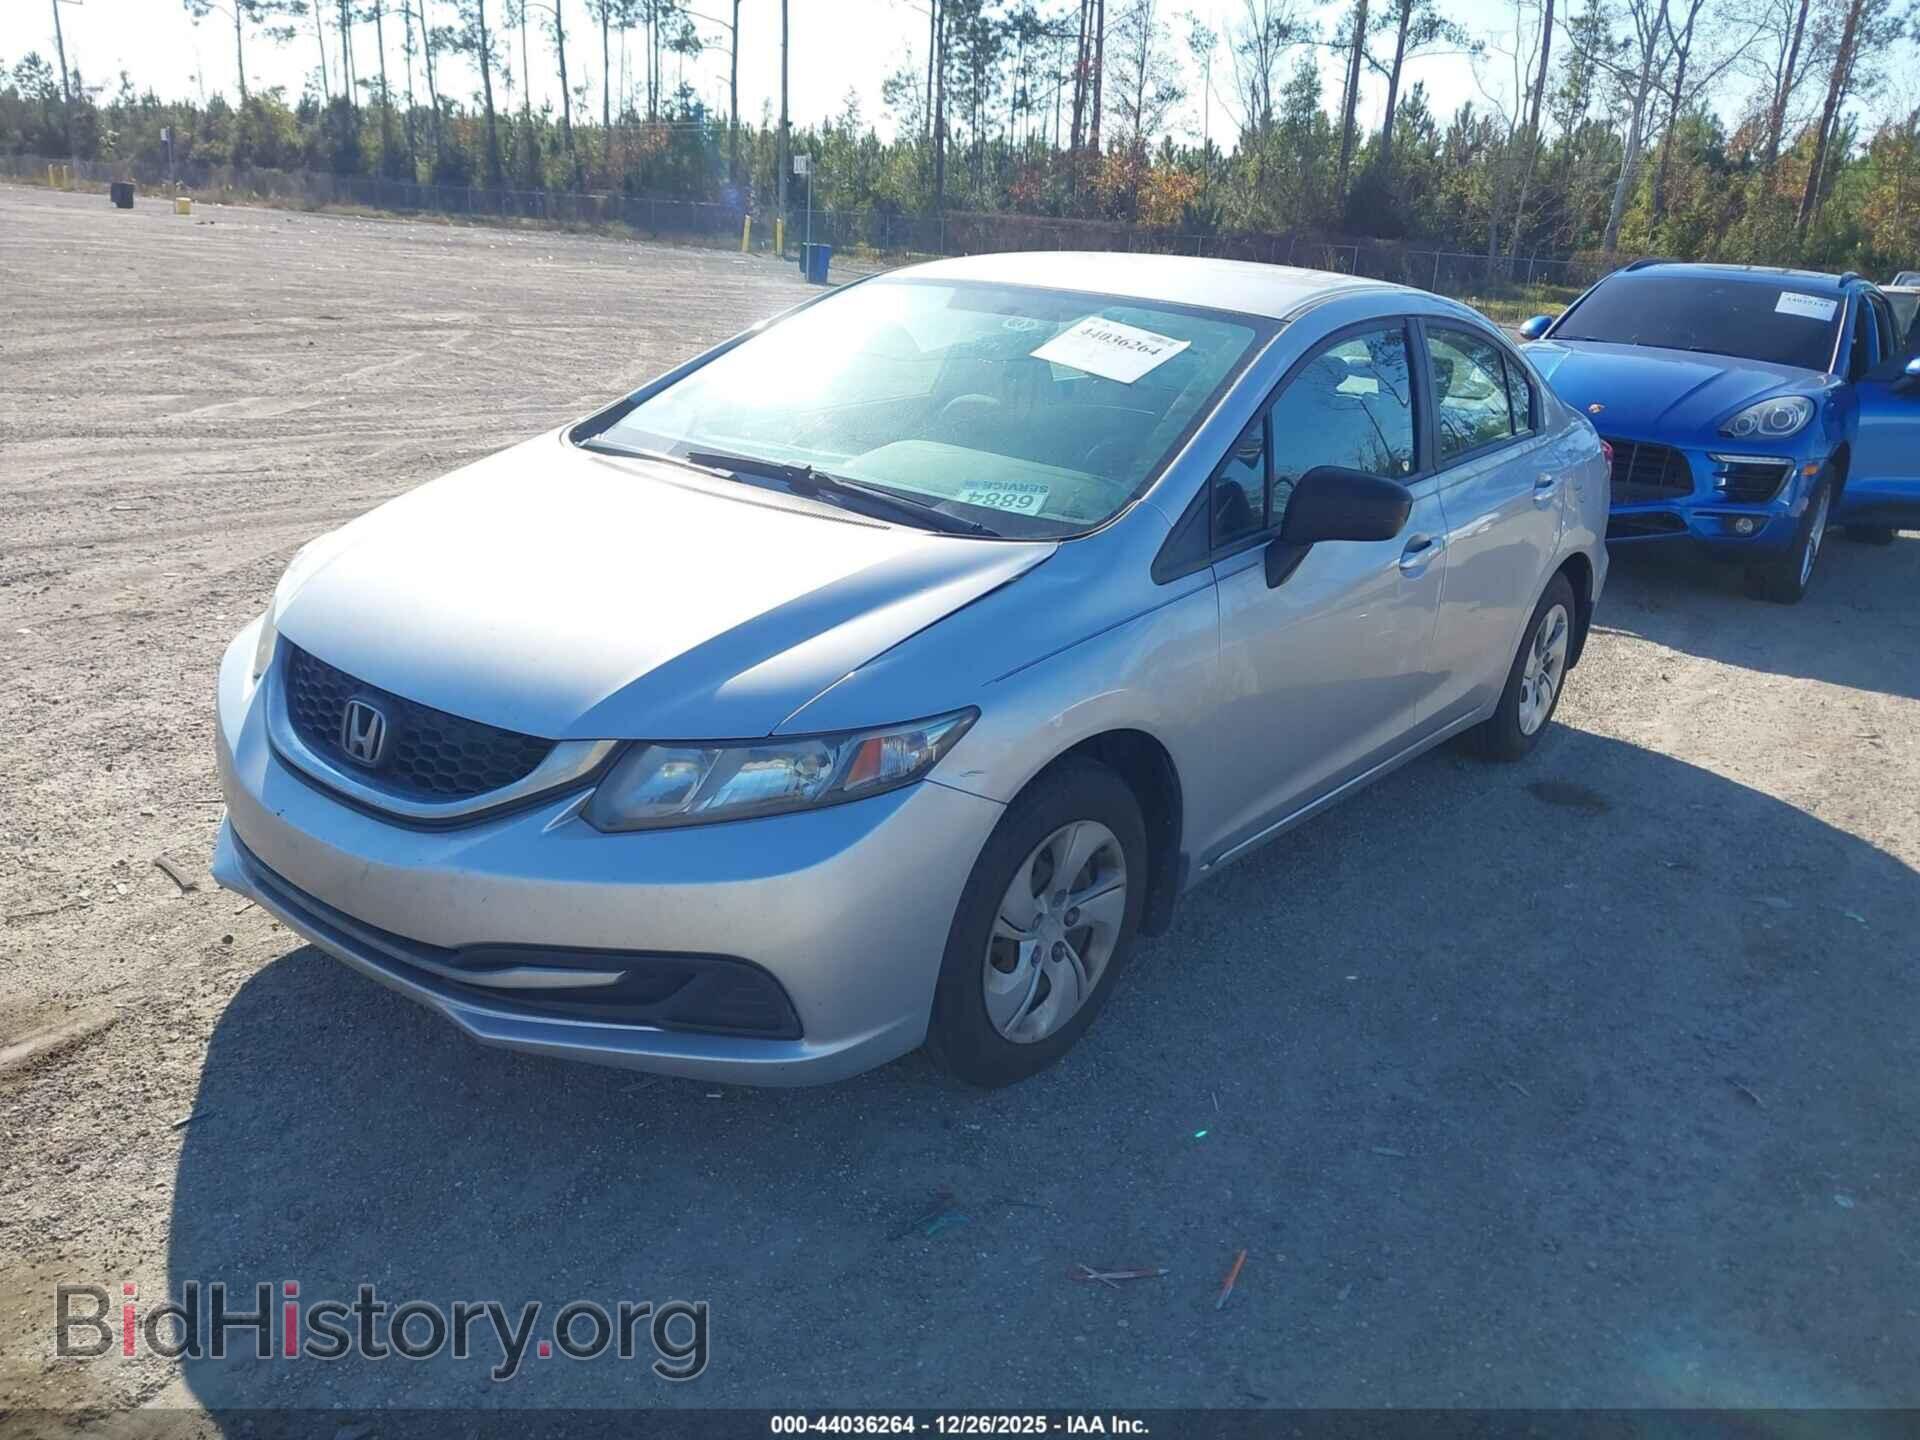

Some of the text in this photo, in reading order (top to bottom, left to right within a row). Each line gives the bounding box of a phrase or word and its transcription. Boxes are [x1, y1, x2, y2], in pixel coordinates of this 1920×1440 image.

[1080, 328, 1162, 356] 44036264
[983, 480, 1049, 493] SERVICE
[967, 491, 1034, 508] 6884
